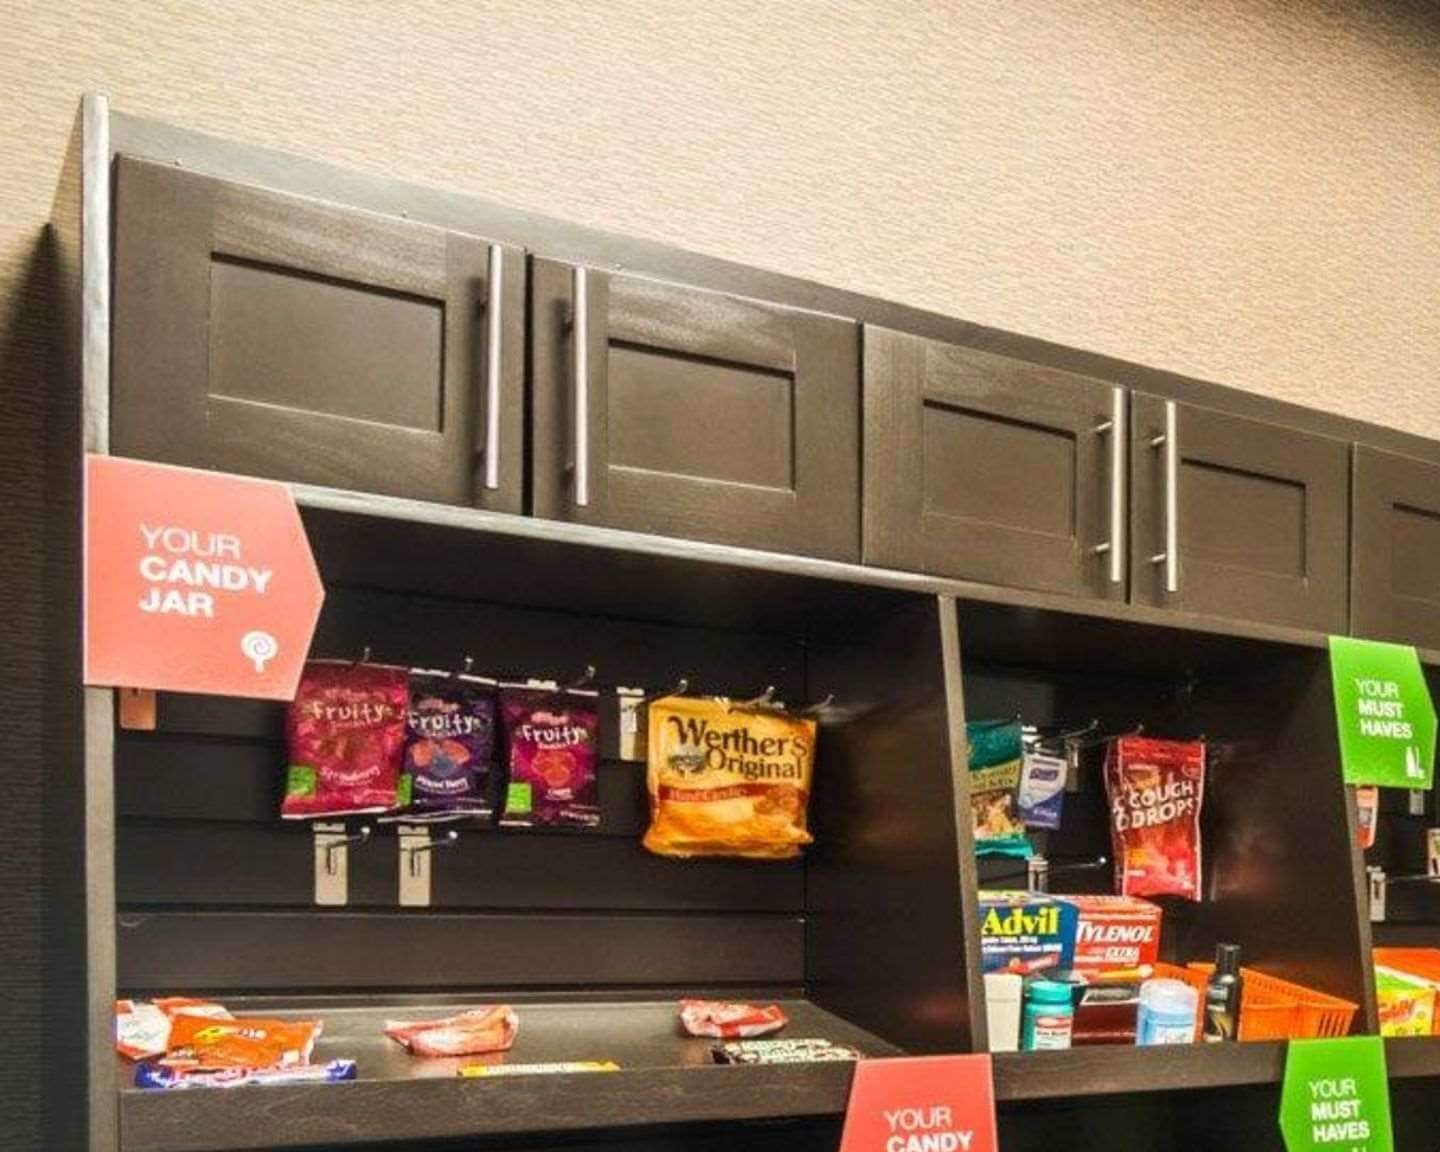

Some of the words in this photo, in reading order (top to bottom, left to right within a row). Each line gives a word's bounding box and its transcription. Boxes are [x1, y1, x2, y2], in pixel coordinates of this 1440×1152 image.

[139, 523, 241, 560] YOUR
[139, 556, 273, 594] CANDY
[138, 588, 215, 618] JAR
[1354, 678, 1399, 697] YOUR
[312, 701, 386, 724] Fruity
[1358, 700, 1404, 719] MUST
[1360, 721, 1413, 739] HAVES
[705, 748, 803, 780] Original
[1129, 780, 1193, 807] COUGH
[982, 907, 1060, 936] Advil
[1077, 921, 1153, 942] TYLENOL
[1309, 1078, 1356, 1098] YOUR
[884, 1106, 953, 1132] YOUR
[1311, 1100, 1361, 1121] MUST
[1313, 1121, 1370, 1142] HAVES
